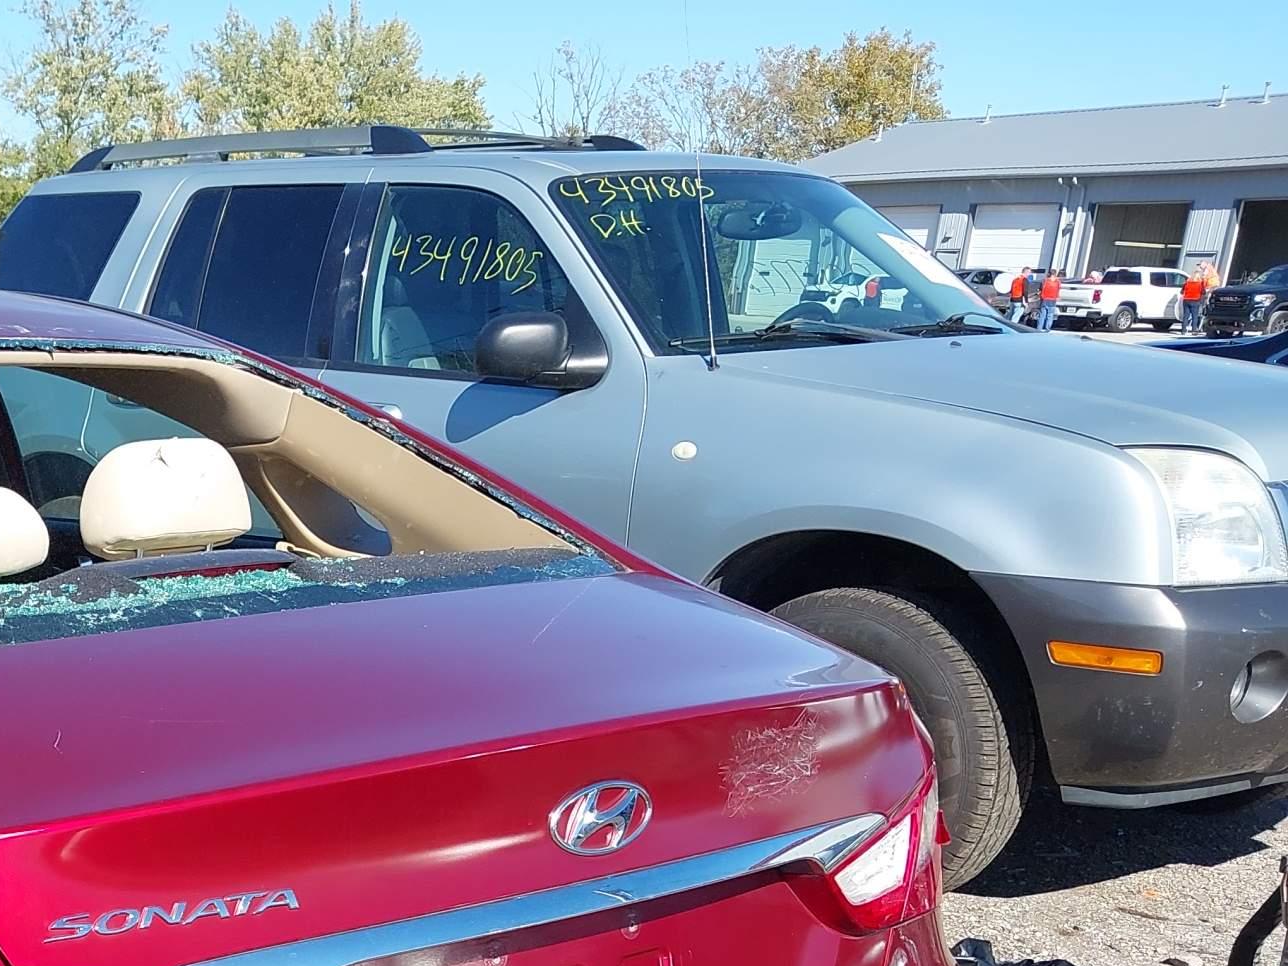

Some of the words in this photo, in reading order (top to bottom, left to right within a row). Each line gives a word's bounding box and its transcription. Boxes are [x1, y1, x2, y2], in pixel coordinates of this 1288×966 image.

[560, 176, 715, 208] 43491805
[392, 234, 544, 295] 43491805
[42, 887, 301, 944] SONATA
